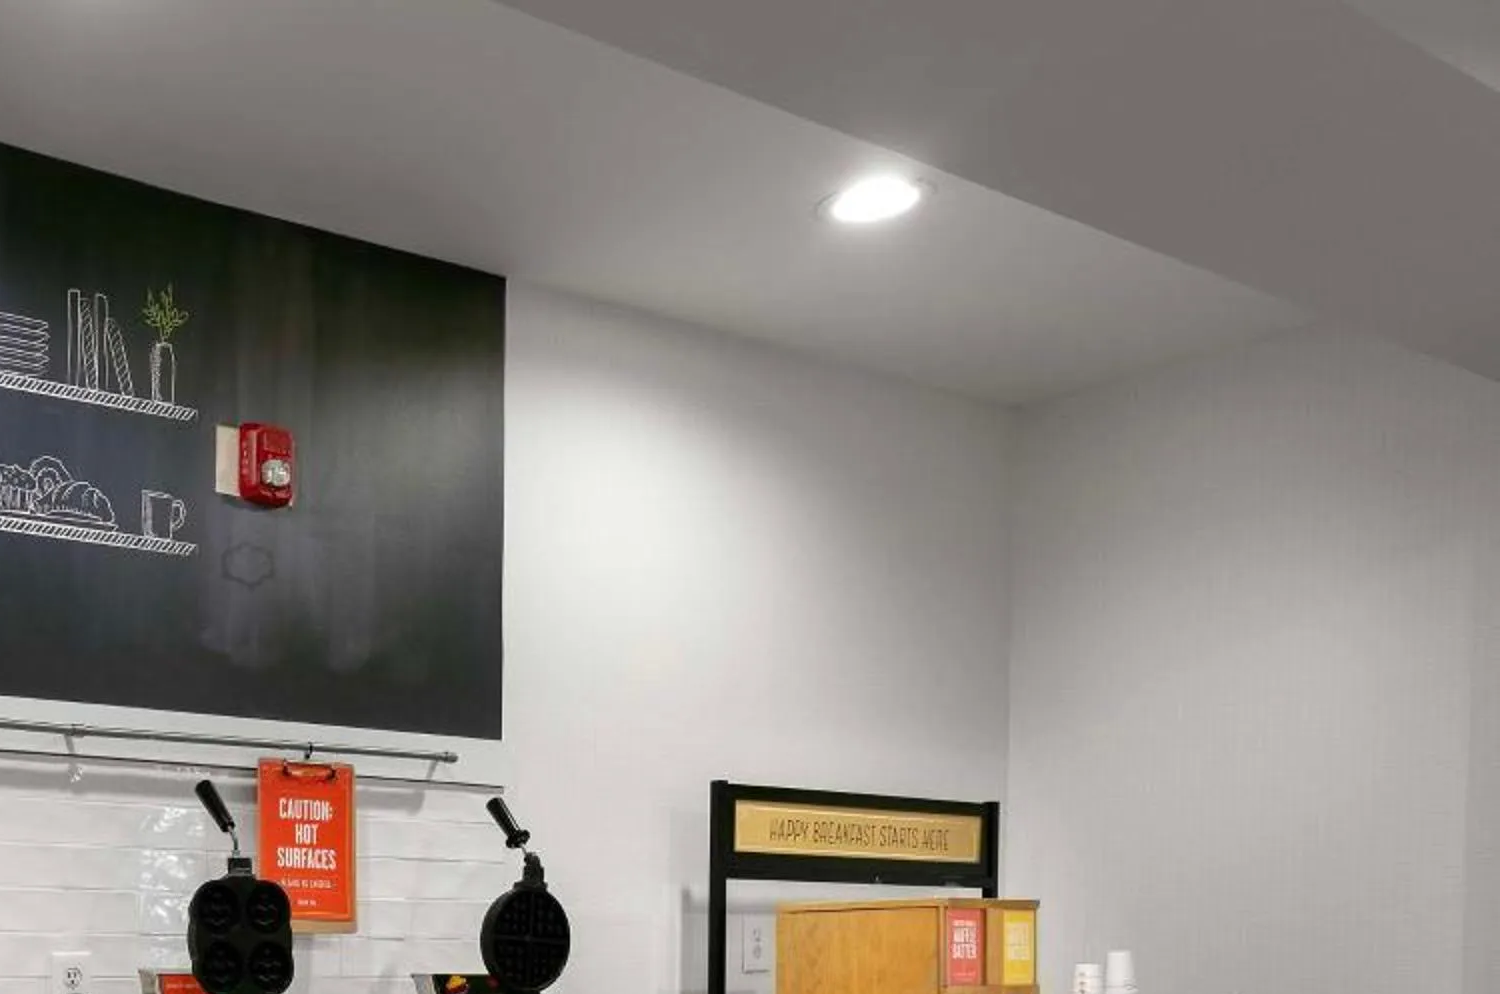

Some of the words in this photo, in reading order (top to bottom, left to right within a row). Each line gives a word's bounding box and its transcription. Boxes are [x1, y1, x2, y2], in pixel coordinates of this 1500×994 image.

[279, 798, 333, 822] CAUTION:
[295, 823, 319, 845] HOT
[769, 818, 809, 842] HAPPY
[814, 821, 877, 847] BREAKFAST
[880, 826, 919, 849] STARTS
[922, 829, 949, 851] HERE
[277, 847, 336, 870] SURFACES
